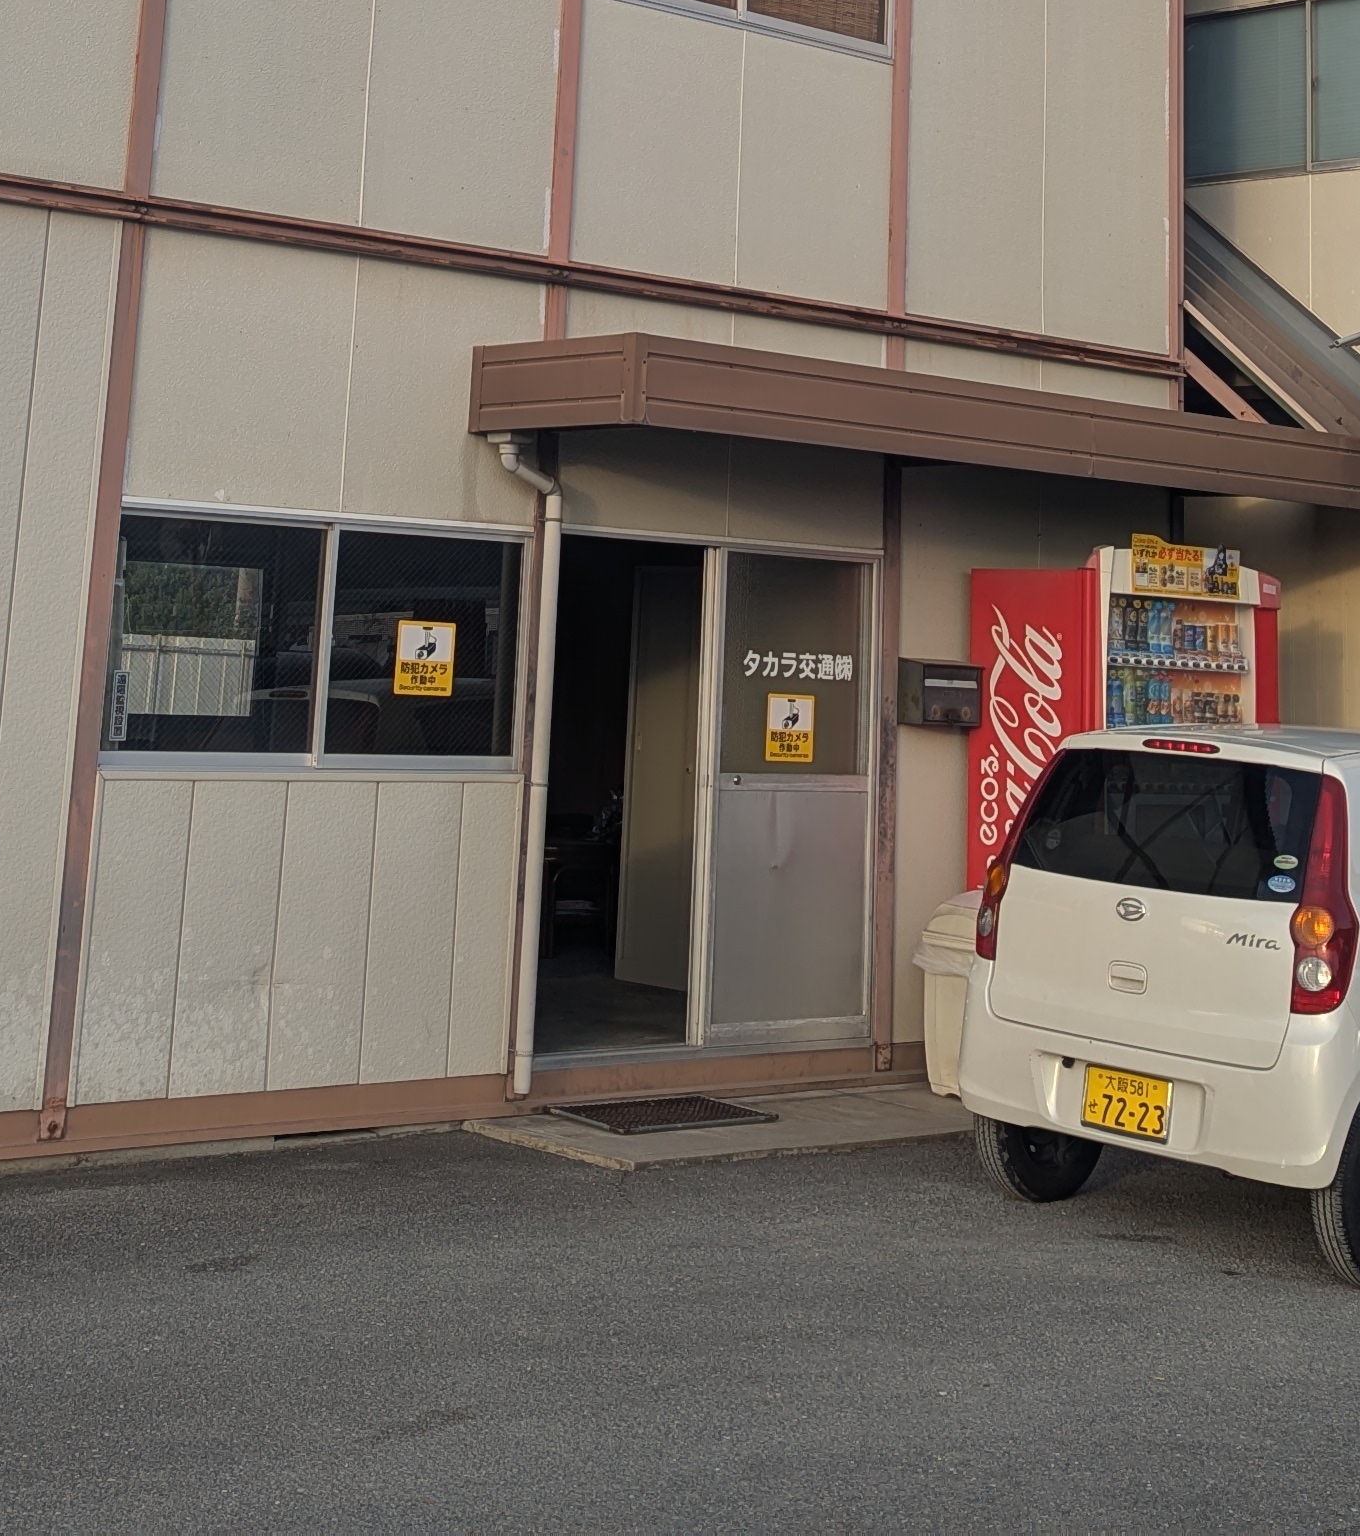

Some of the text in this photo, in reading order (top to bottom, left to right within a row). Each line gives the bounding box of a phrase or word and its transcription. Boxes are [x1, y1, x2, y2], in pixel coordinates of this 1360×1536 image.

[400, 661, 448, 675] 防犯カメラ
[410, 674, 436, 685] 作動中
[770, 731, 809, 743] 防犯カメラ
[1226, 933, 1281, 951] Mira
[1088, 1093, 1165, 1135] せ 72-23
